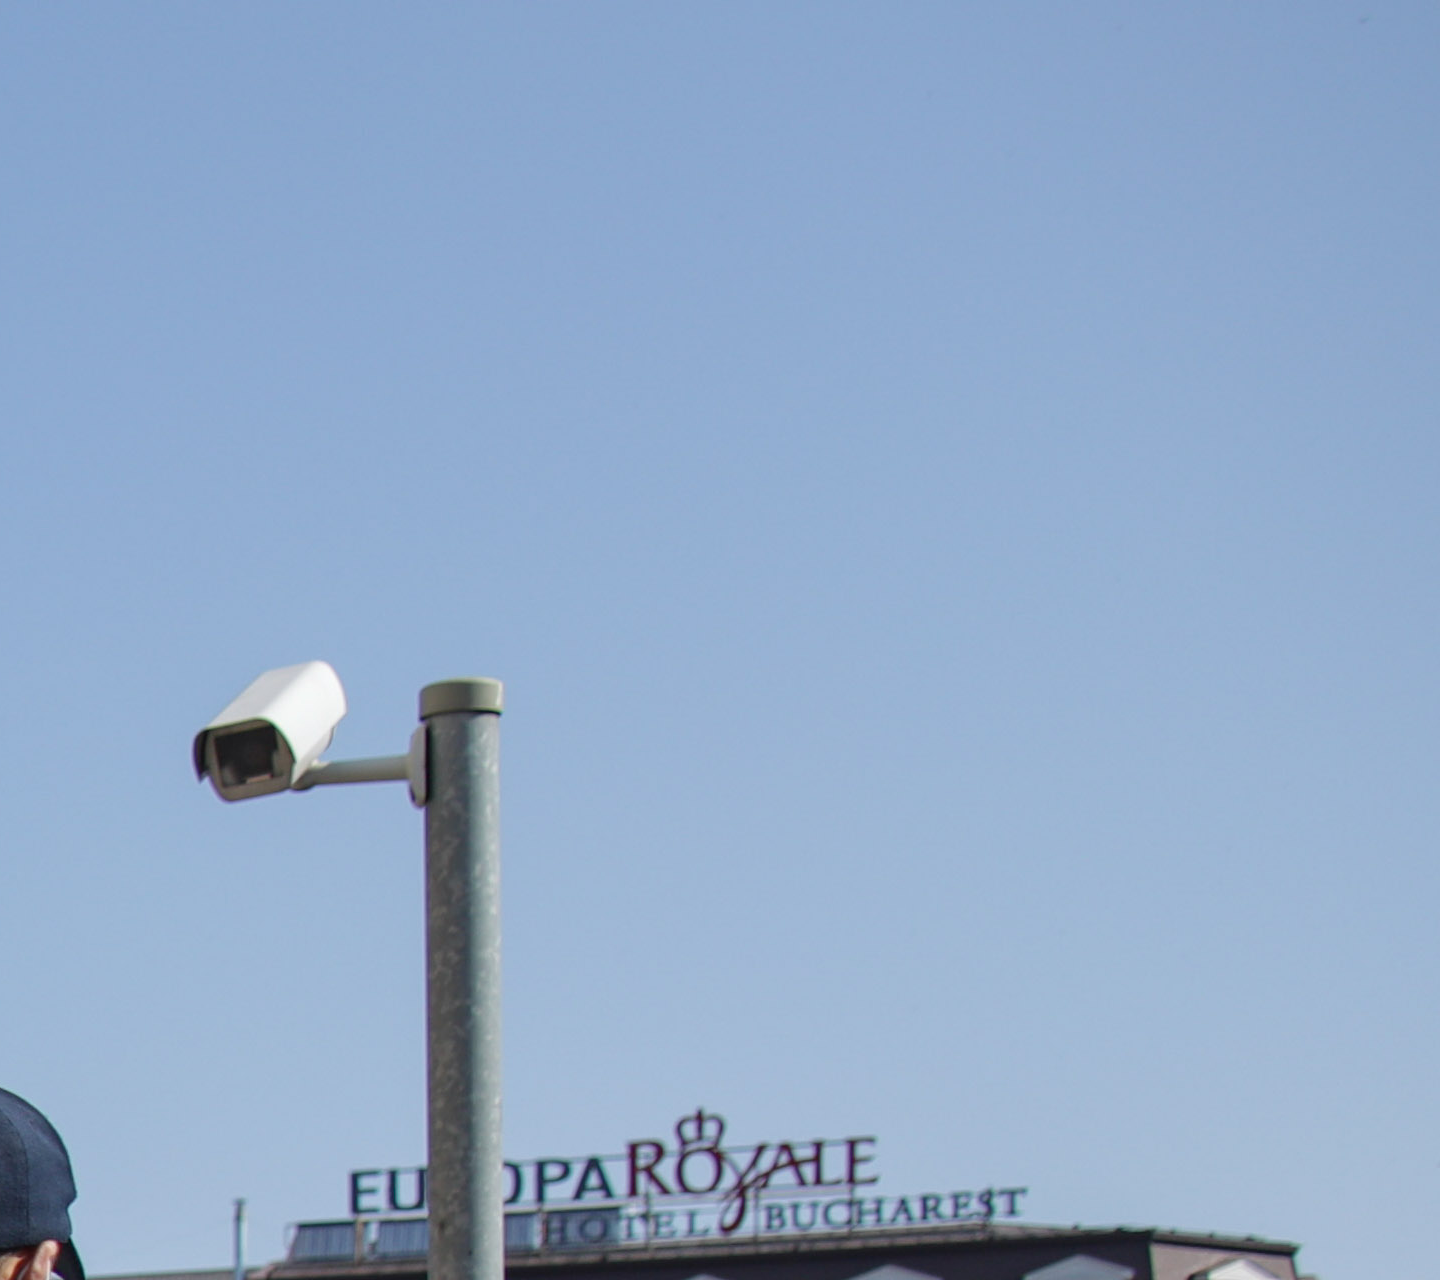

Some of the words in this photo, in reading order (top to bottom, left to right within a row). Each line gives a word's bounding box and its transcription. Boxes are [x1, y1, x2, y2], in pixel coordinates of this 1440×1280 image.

[543, 1206, 711, 1248] HOTEL
[764, 1187, 1029, 1232] BUCHAREST
[627, 1135, 880, 1233] ROYALE
